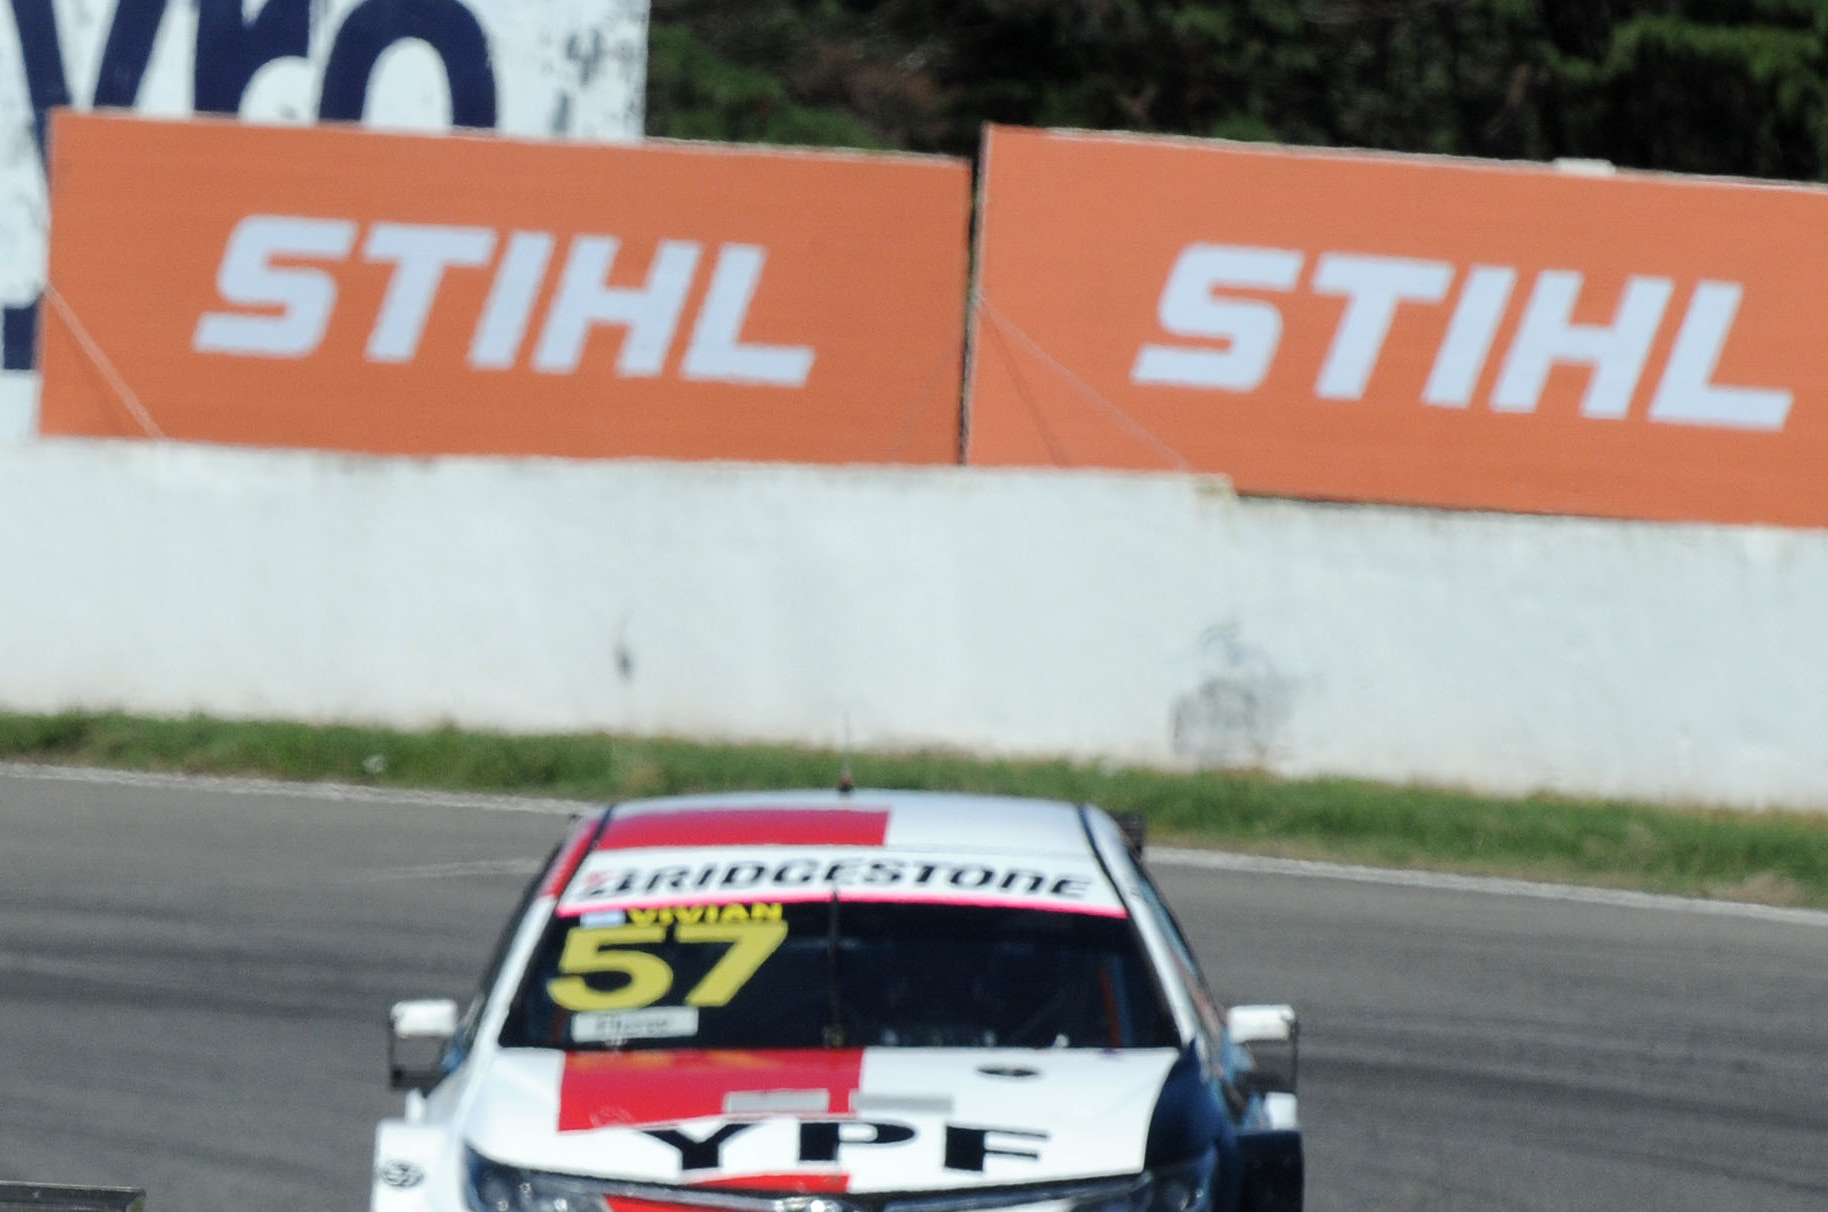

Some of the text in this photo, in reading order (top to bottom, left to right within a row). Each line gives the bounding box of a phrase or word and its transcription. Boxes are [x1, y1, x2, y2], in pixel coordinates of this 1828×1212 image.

[192, 214, 816, 388] STIHL
[1129, 241, 1796, 431] STIHL
[583, 857, 1092, 899] BRIDGESTONE
[628, 902, 783, 926] VIVIAN
[546, 919, 789, 1011] 57
[642, 1120, 1051, 1173] YPF
